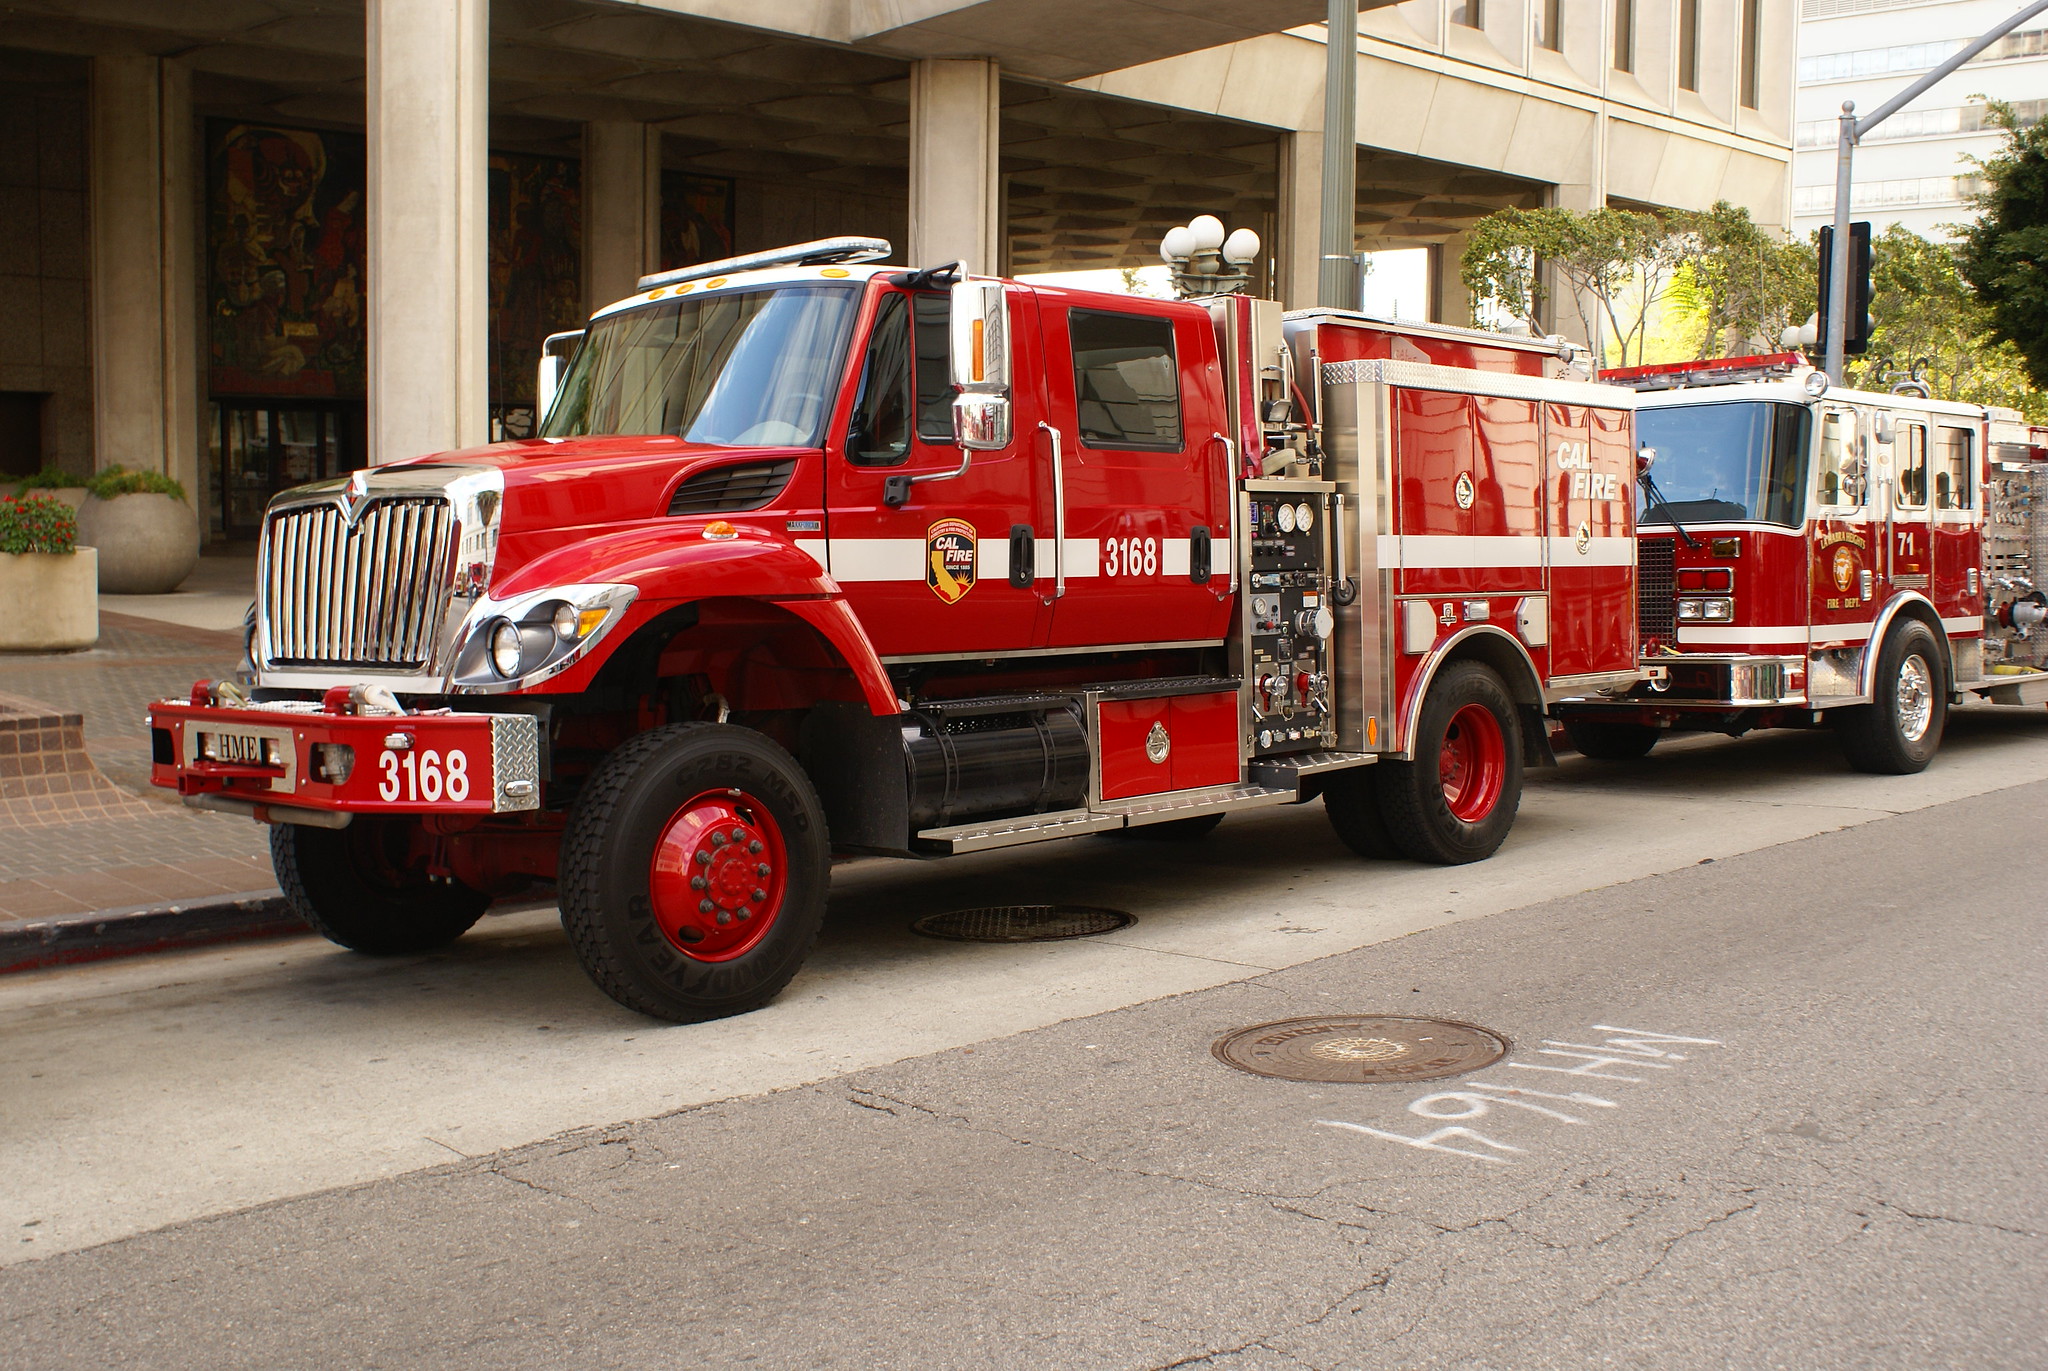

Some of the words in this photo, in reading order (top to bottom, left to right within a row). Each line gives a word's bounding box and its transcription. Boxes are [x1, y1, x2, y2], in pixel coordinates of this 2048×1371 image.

[1557, 441, 1592, 470] CAL
[1572, 472, 1616, 499] FIRE
[935, 537, 959, 549] CAL
[1845, 532, 1865, 550] HEIGHTS
[1897, 532, 1914, 556] 71
[946, 549, 973, 562] FIRE
[1105, 537, 1157, 577] 3168
[1827, 598, 1839, 609] FIRE
[1844, 597, 1860, 608] DEPT.
[219, 734, 258, 760] HME
[378, 749, 470, 801] 3168
[1313, 1081, 1619, 1166] 164
